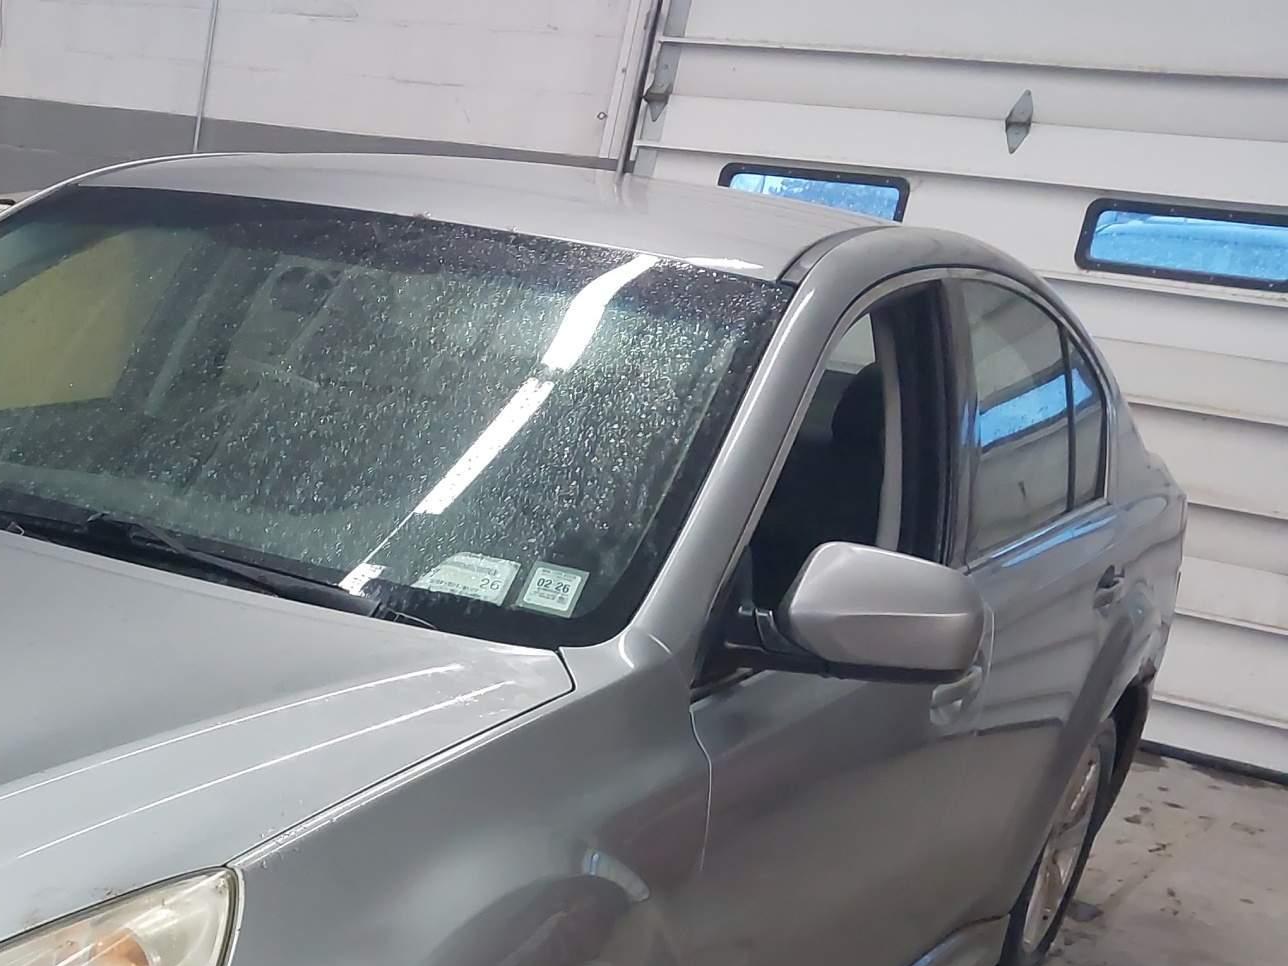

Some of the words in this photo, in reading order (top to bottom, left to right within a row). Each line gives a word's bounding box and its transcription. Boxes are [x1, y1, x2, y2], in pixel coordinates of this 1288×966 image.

[479, 577, 500, 591] 26
[537, 578, 553, 589] 02
[555, 582, 570, 594] 26
